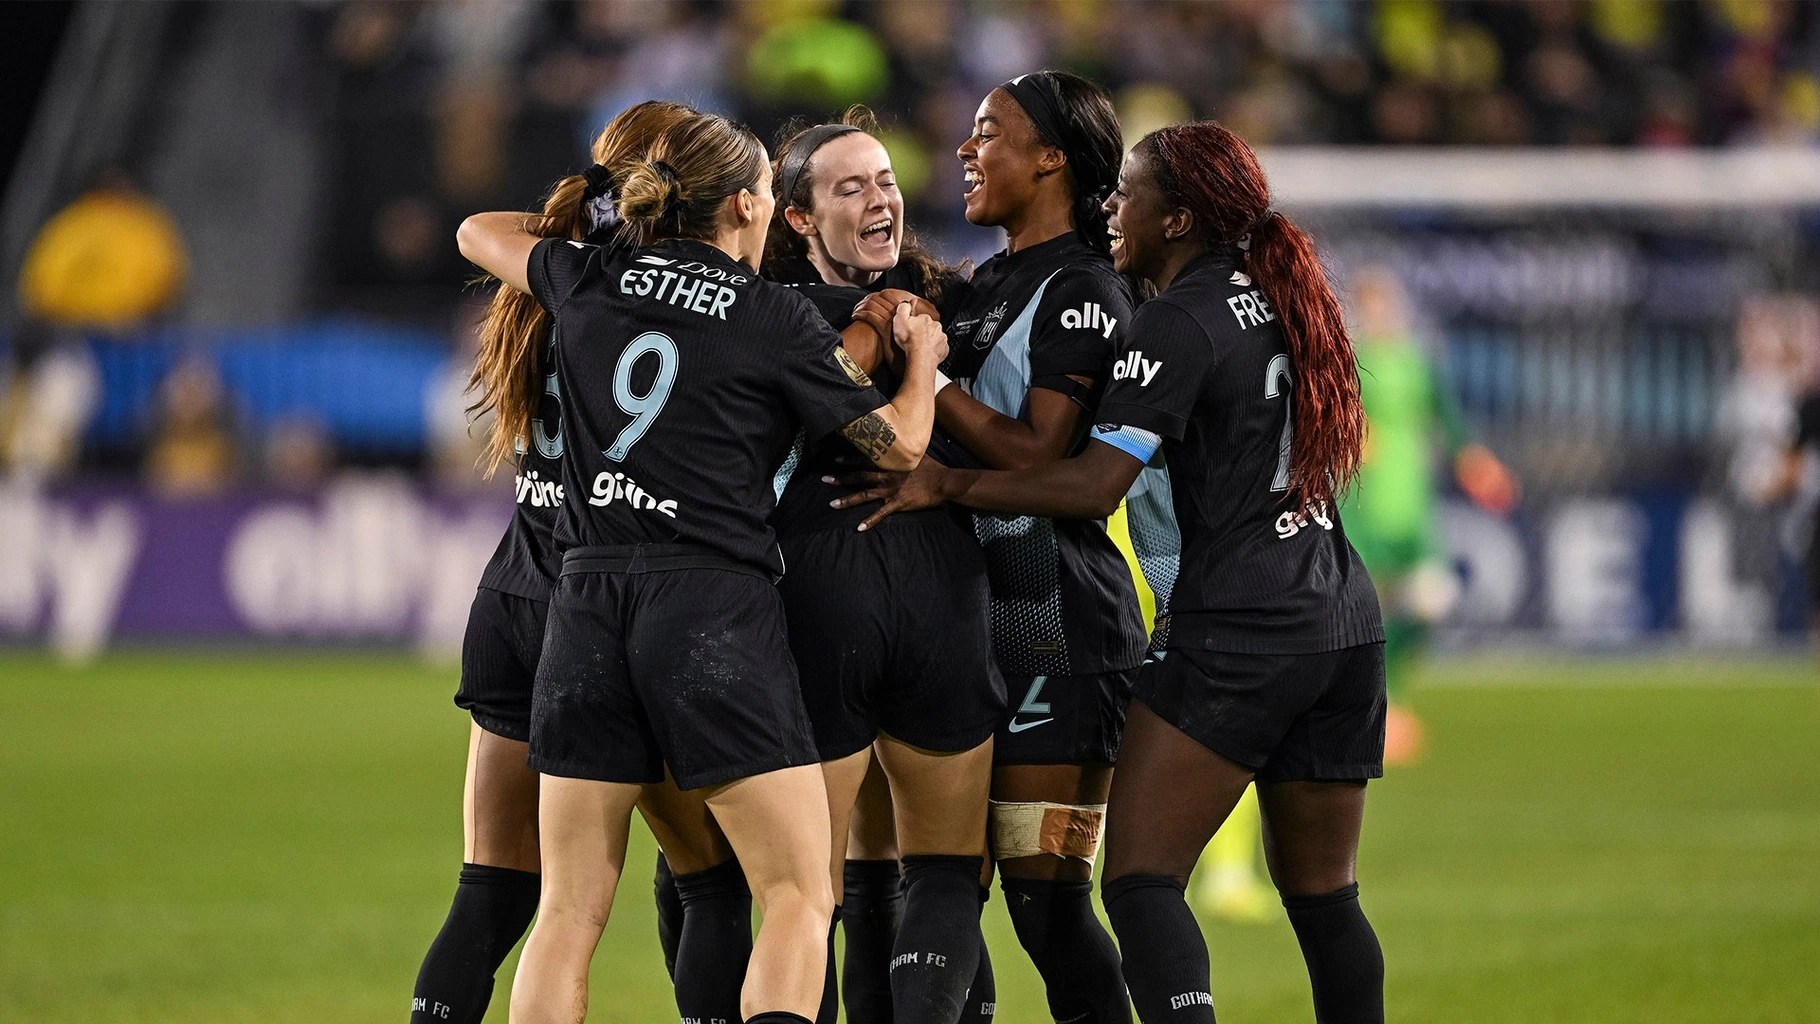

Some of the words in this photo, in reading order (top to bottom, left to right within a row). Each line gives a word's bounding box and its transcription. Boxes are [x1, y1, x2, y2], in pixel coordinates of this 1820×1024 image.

[677, 261, 748, 286] Dove
[619, 268, 738, 321] ESTHER
[1060, 301, 1118, 340] ally
[1112, 350, 1164, 388] ally
[601, 331, 681, 463] 9
[926, 952, 947, 968] FC
[432, 1001, 451, 1020] FC
